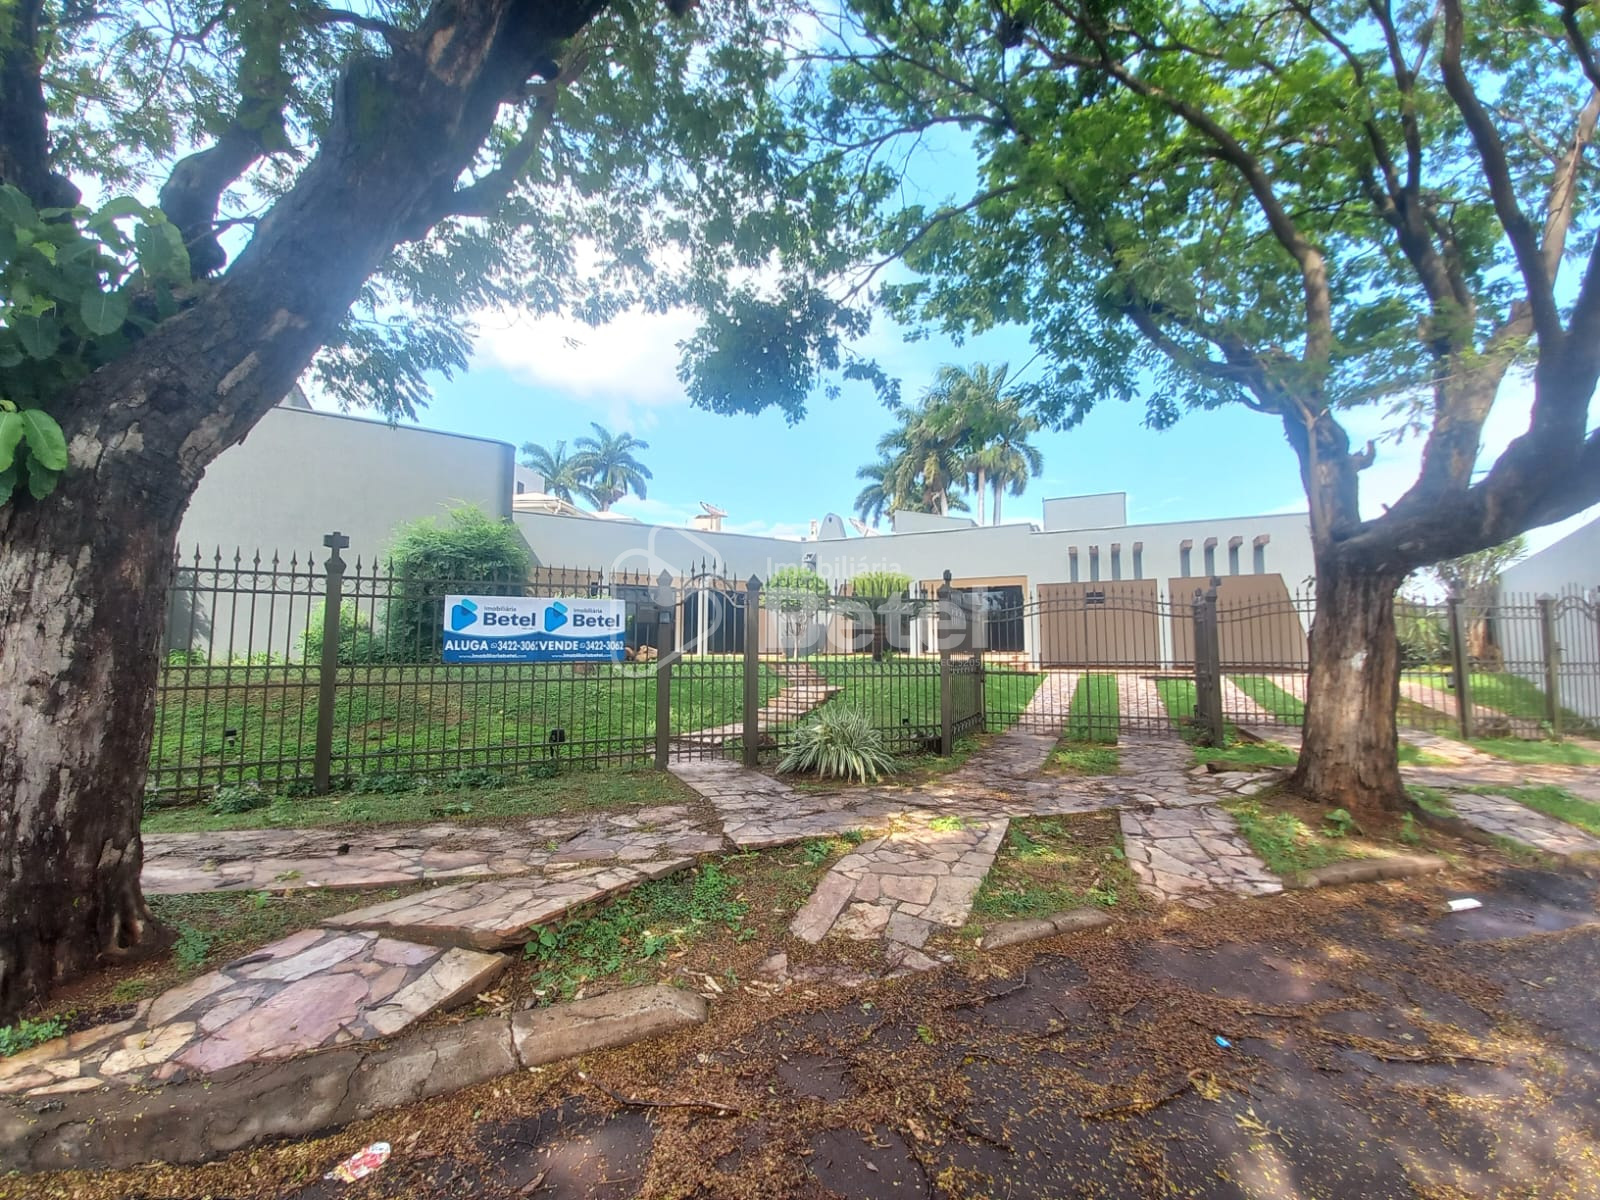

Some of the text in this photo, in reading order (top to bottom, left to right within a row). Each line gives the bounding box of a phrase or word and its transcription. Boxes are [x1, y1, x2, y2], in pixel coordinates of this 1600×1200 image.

[483, 613, 536, 626] Betel
[573, 614, 620, 627] Betel
[444, 640, 489, 651] ALUGA
[539, 640, 624, 651] VENDE 3422-3062
